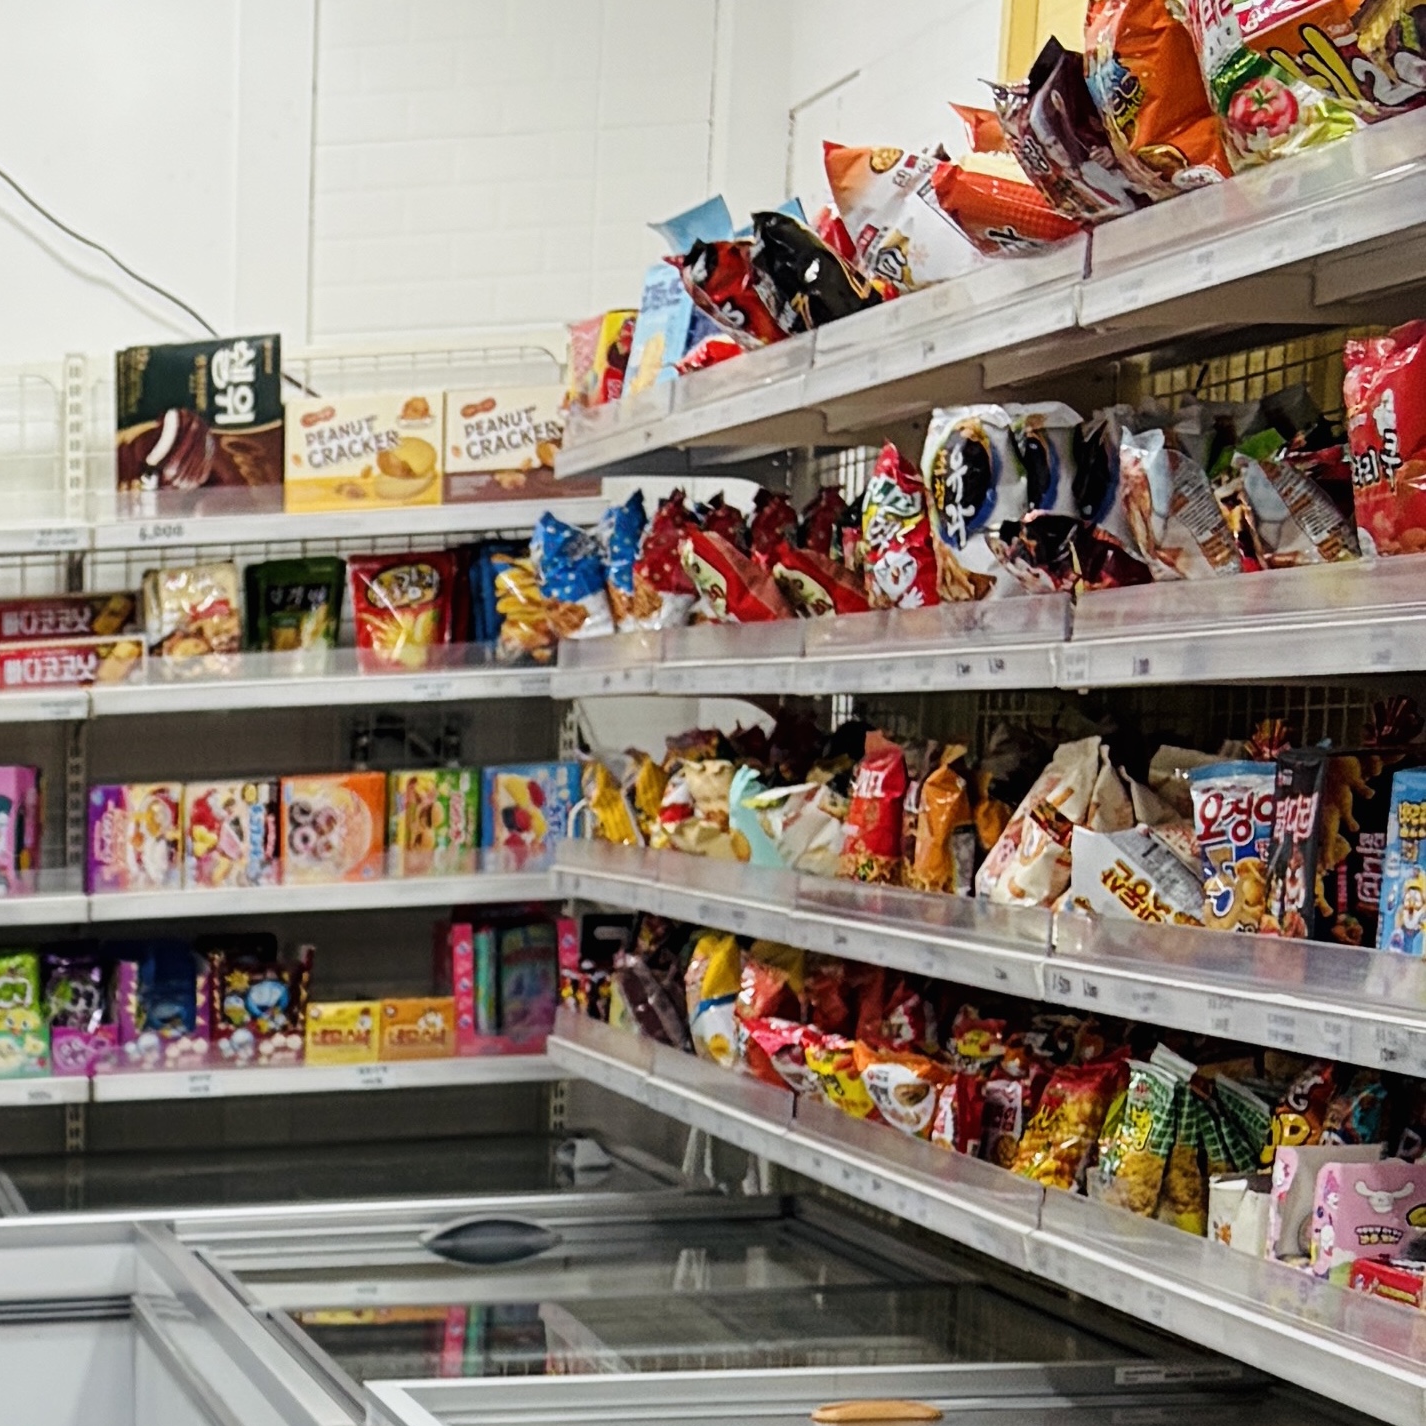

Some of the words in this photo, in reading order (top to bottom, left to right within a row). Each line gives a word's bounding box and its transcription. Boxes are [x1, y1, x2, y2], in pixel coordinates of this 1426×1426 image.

[210, 340, 256, 425] 쉘위
[304, 414, 378, 448] PEANUT
[463, 404, 537, 440] PEANUT
[465, 419, 565, 462] CRACKER
[306, 428, 401, 470] CRACKER
